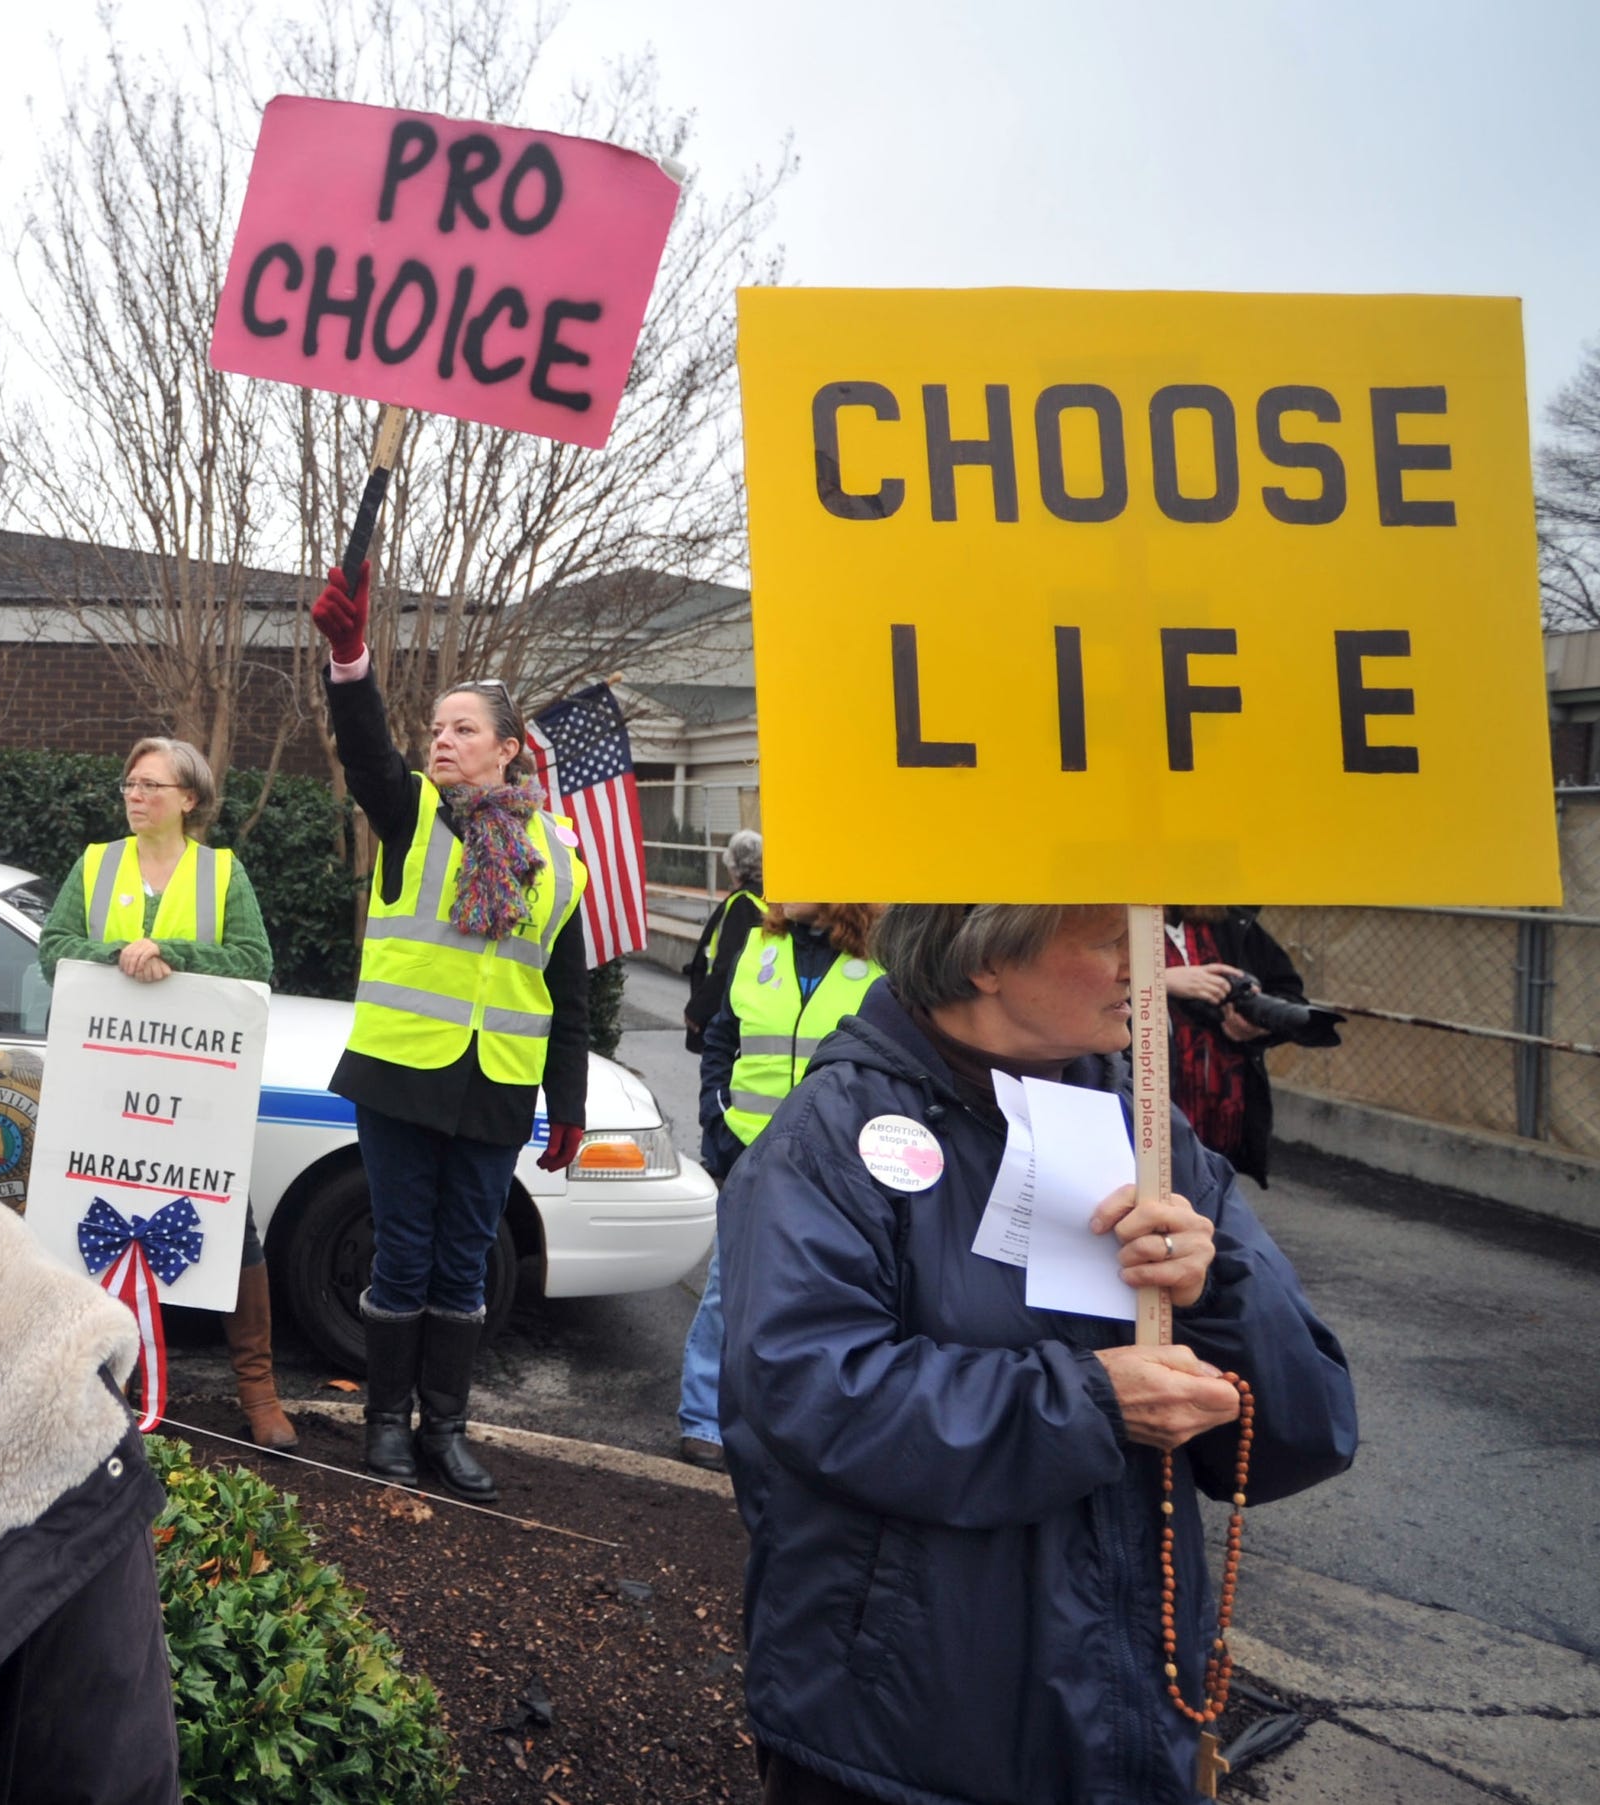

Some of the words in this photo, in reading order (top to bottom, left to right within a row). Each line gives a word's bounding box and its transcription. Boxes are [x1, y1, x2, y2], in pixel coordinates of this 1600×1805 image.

[377, 119, 564, 236] PRO
[241, 241, 604, 416] CHOICE
[812, 381, 1457, 527] CHOOSE
[890, 624, 1420, 775] LIFE
[1140, 986, 1153, 1021] The
[88, 1015, 244, 1055] HEALTHCARE
[1139, 1024, 1155, 1093] helpful
[124, 1090, 182, 1119] NOT
[868, 1122, 928, 1139] ABORTION
[879, 1134, 909, 1146] stops
[1140, 1099, 1156, 1155] place.
[67, 1150, 236, 1194] HARASSMENT
[869, 1162, 911, 1177] beating
[891, 1173, 922, 1187] heart
